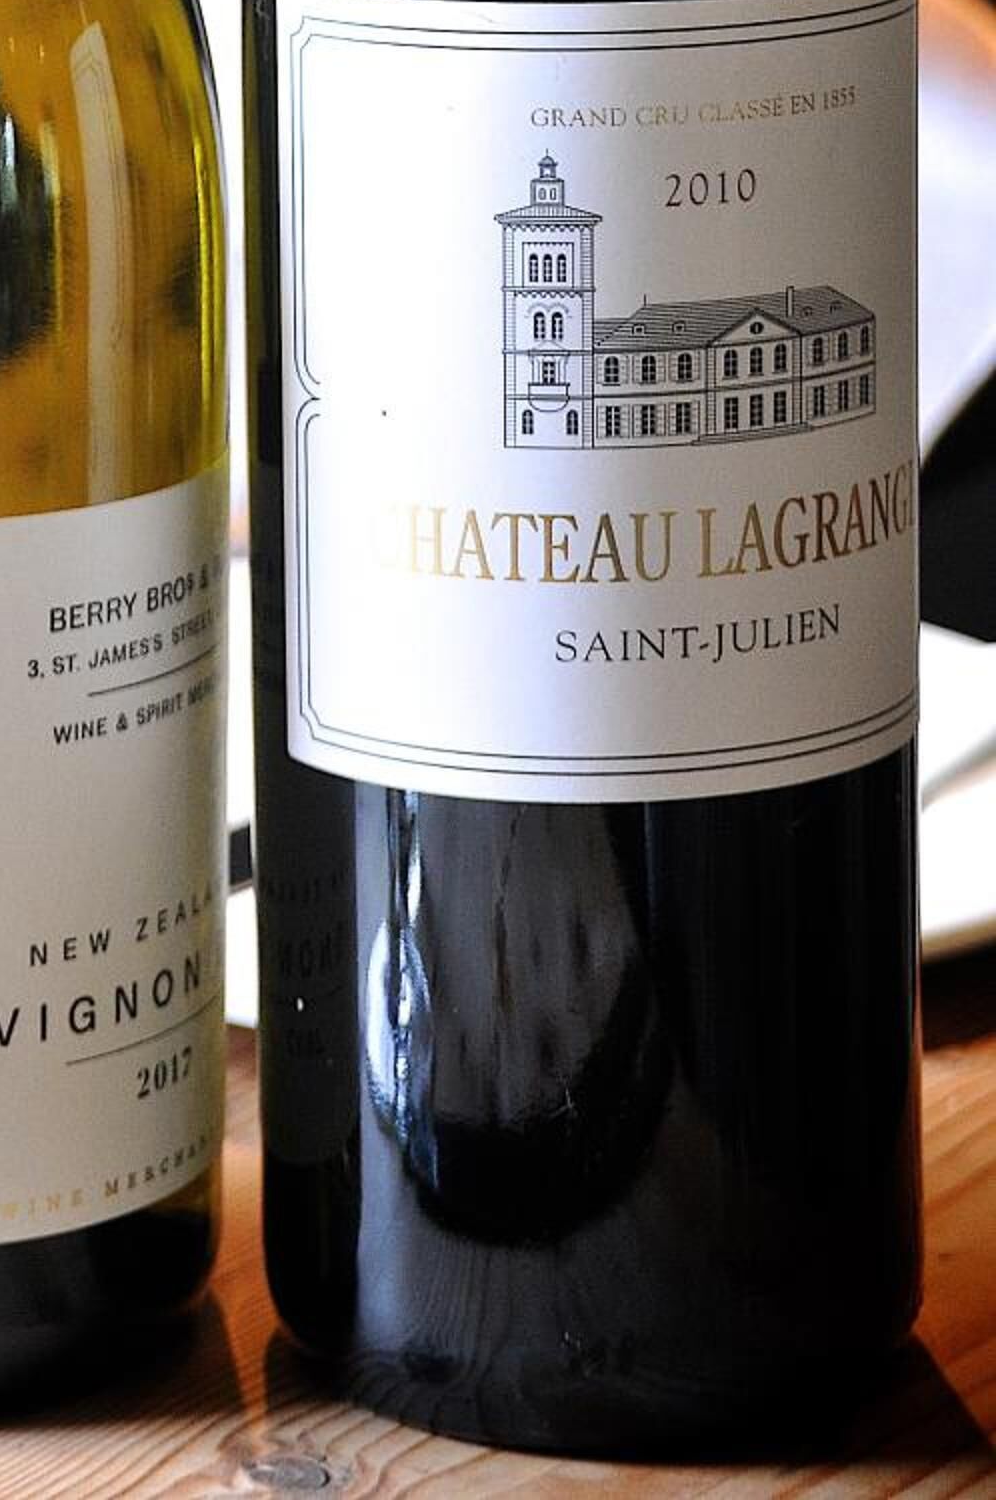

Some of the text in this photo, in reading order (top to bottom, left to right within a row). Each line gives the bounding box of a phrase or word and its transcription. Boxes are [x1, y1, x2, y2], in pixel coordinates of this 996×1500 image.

[530, 106, 627, 129] GRAND
[635, 105, 690, 128] CRU
[790, 90, 817, 115] EN
[822, 83, 858, 111] 1855
[664, 168, 757, 208] 2010
[386, 501, 679, 584] HATEAU
[49, 592, 138, 634] BERRY
[554, 603, 842, 663] SAINT-JULIEN
[52, 653, 81, 676] ST.
[54, 691, 185, 746] WINE & SPIRIT
[29, 927, 112, 968] NEW
[137, 1045, 193, 1100] 2017
